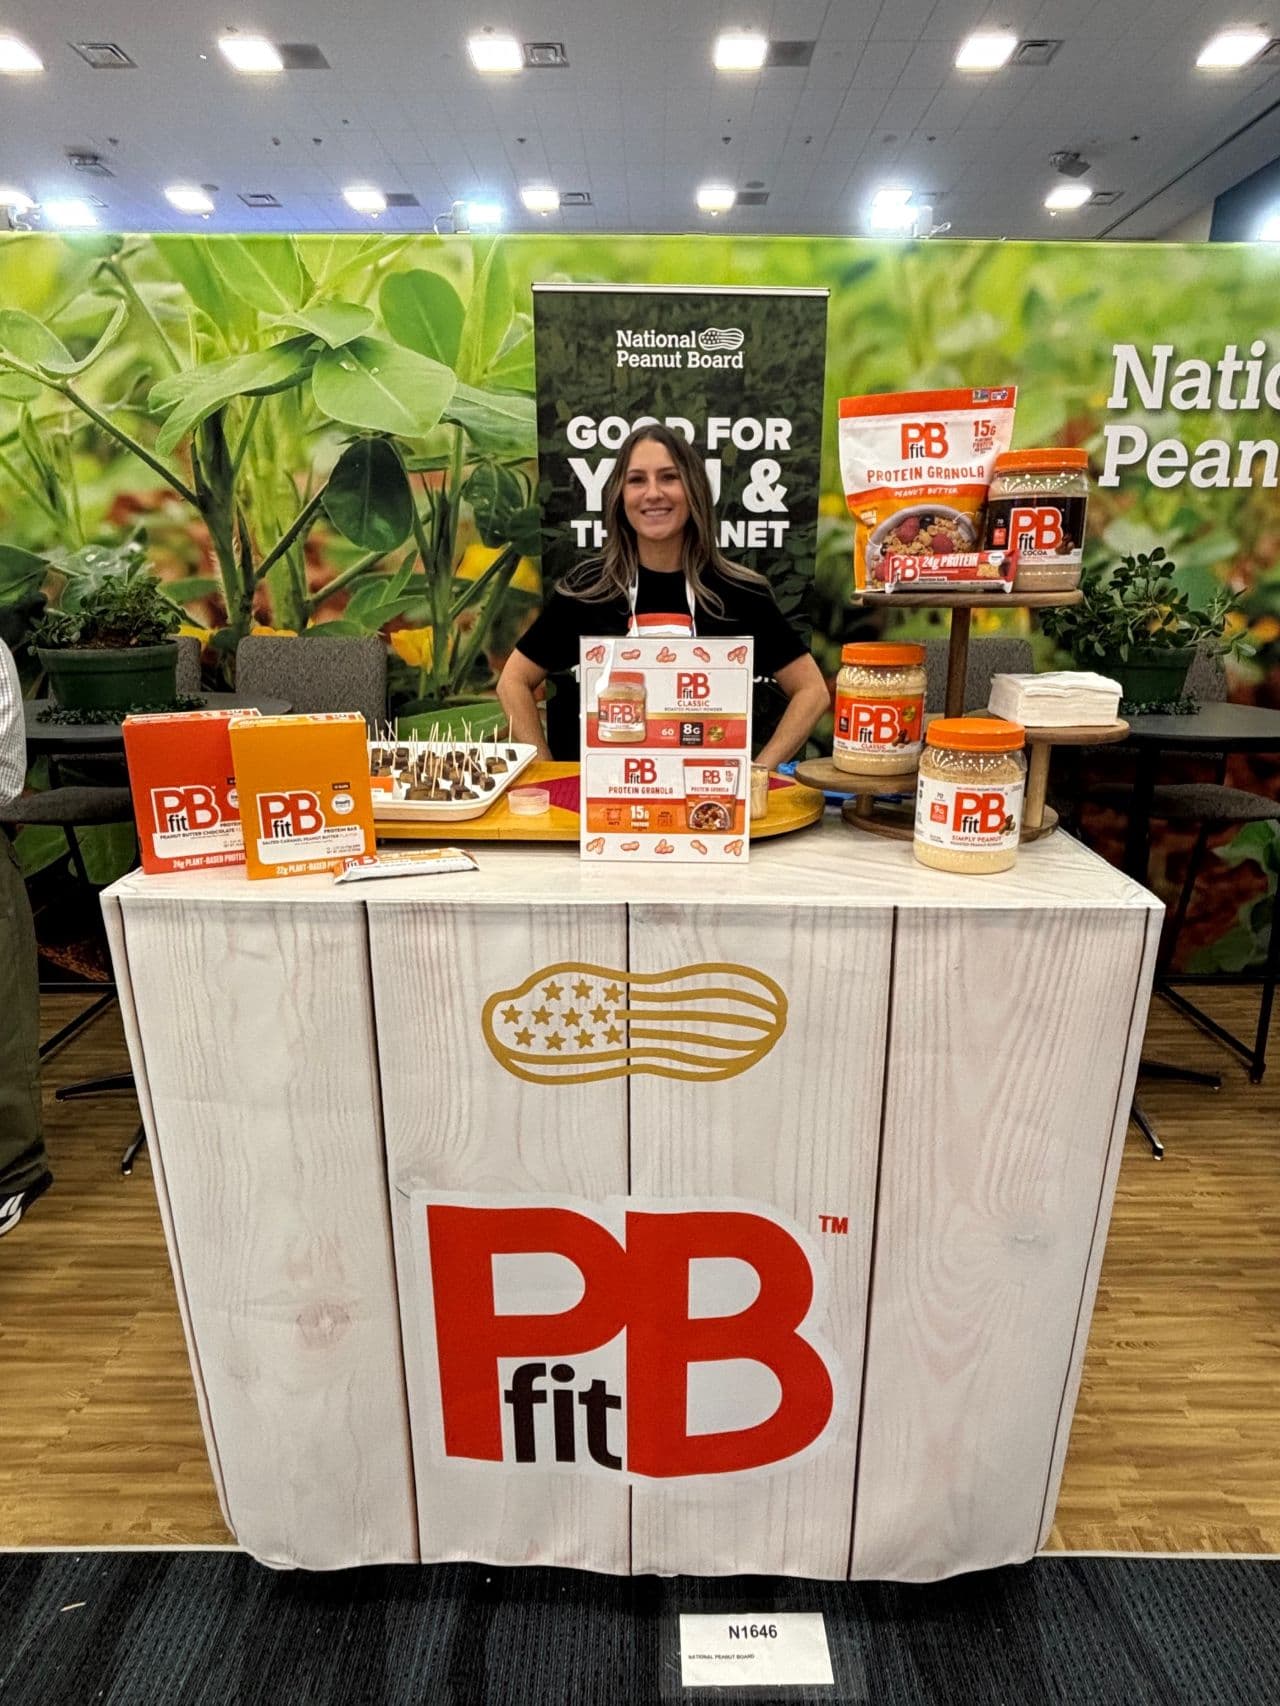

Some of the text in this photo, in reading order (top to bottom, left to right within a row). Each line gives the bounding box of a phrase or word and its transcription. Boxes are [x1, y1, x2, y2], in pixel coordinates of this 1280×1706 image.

[616, 329, 697, 348] National
[616, 350, 744, 368] Peanut Board
[707, 417, 792, 450] FOR
[867, 466, 984, 483] PROTEIN GRANOLA
[742, 458, 789, 513] &
[922, 553, 980, 570] 24g PROTEIN
[662, 728, 674, 736] 60
[608, 786, 639, 794] PROTEIN
[168, 814, 188, 832] fit
[273, 820, 292, 838] fit
[962, 816, 979, 833] fit
[818, 1214, 848, 1234] TM
[427, 1204, 833, 1478] PB
[504, 1363, 622, 1471] fit
[728, 1624, 778, 1639] N1646
